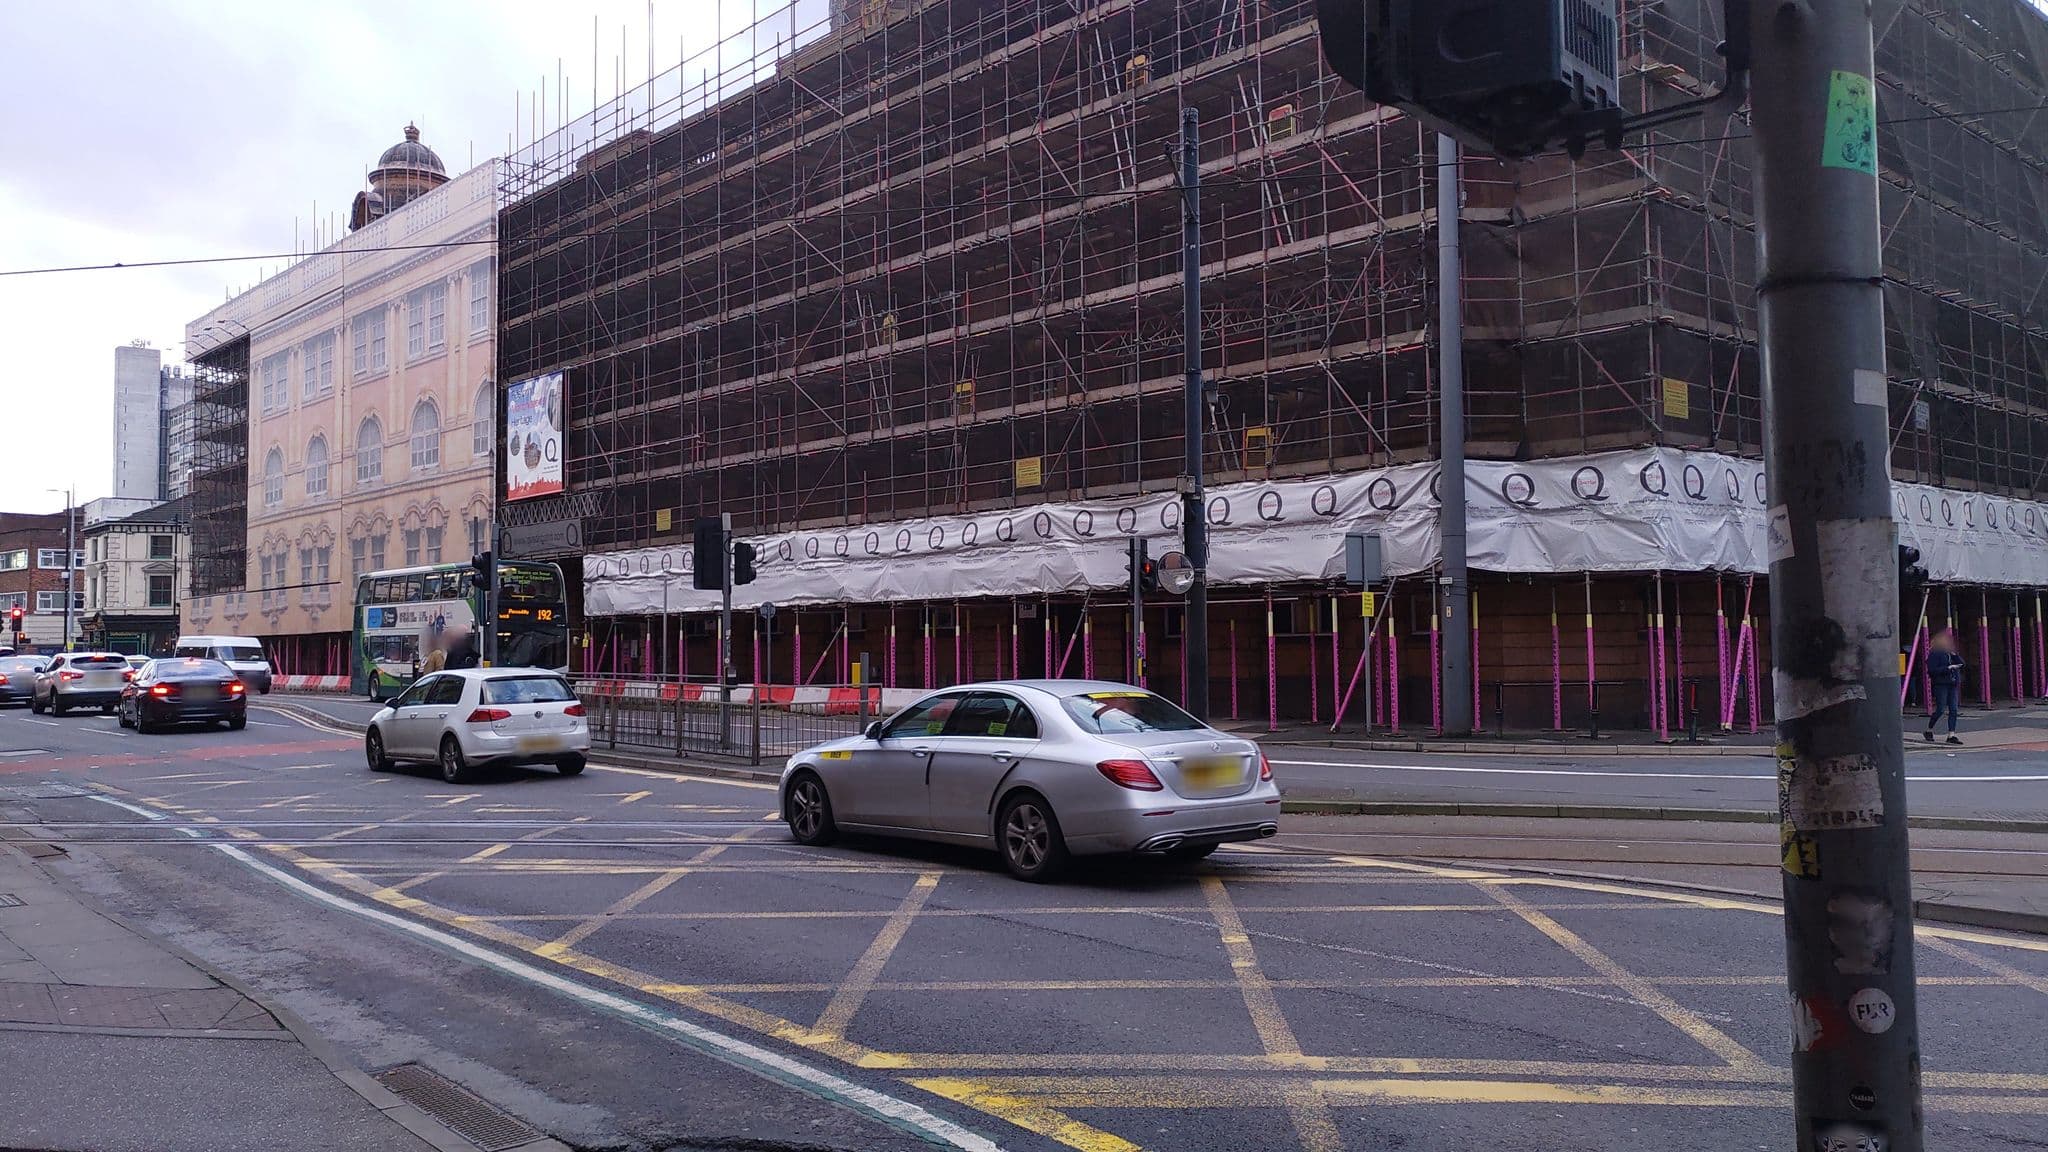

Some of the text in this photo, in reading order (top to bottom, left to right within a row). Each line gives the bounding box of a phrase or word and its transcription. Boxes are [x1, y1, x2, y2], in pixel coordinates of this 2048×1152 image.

[545, 437, 558, 462] Q
[1684, 464, 1708, 500] Q
[1726, 468, 1743, 503] Q
[1897, 492, 1909, 520] Q
[1920, 494, 1932, 523] Q
[1942, 498, 1954, 526] Q
[1986, 503, 1998, 529] Q
[2006, 506, 2016, 532] Q
[2025, 508, 2035, 534] Q
[596, 560, 606, 576] Q
[619, 558, 629, 576] Q
[640, 556, 649, 573] Q
[662, 553, 672, 572] Q
[683, 551, 694, 570] Q
[779, 540, 794, 561] Q
[806, 537, 818, 558] Q
[834, 535, 849, 556] Q
[865, 532, 879, 554] Q
[896, 529, 911, 552] Q
[929, 526, 944, 550] Q
[962, 522, 978, 546] Q
[996, 518, 1018, 542] Q
[1034, 512, 1053, 538] Q
[1073, 510, 1095, 536] Q
[1117, 508, 1138, 532] Q
[1160, 502, 1180, 530] Q
[1208, 496, 1232, 525] Q
[1258, 491, 1283, 521] Q
[1312, 486, 1340, 516] Q
[1368, 478, 1398, 510] Q
[1502, 473, 1540, 506] Q
[1571, 466, 1608, 501] Q
[1640, 460, 1668, 497] Q
[503, 532, 514, 553] Q
[566, 523, 581, 547] Q
[538, 609, 552, 621] 192
